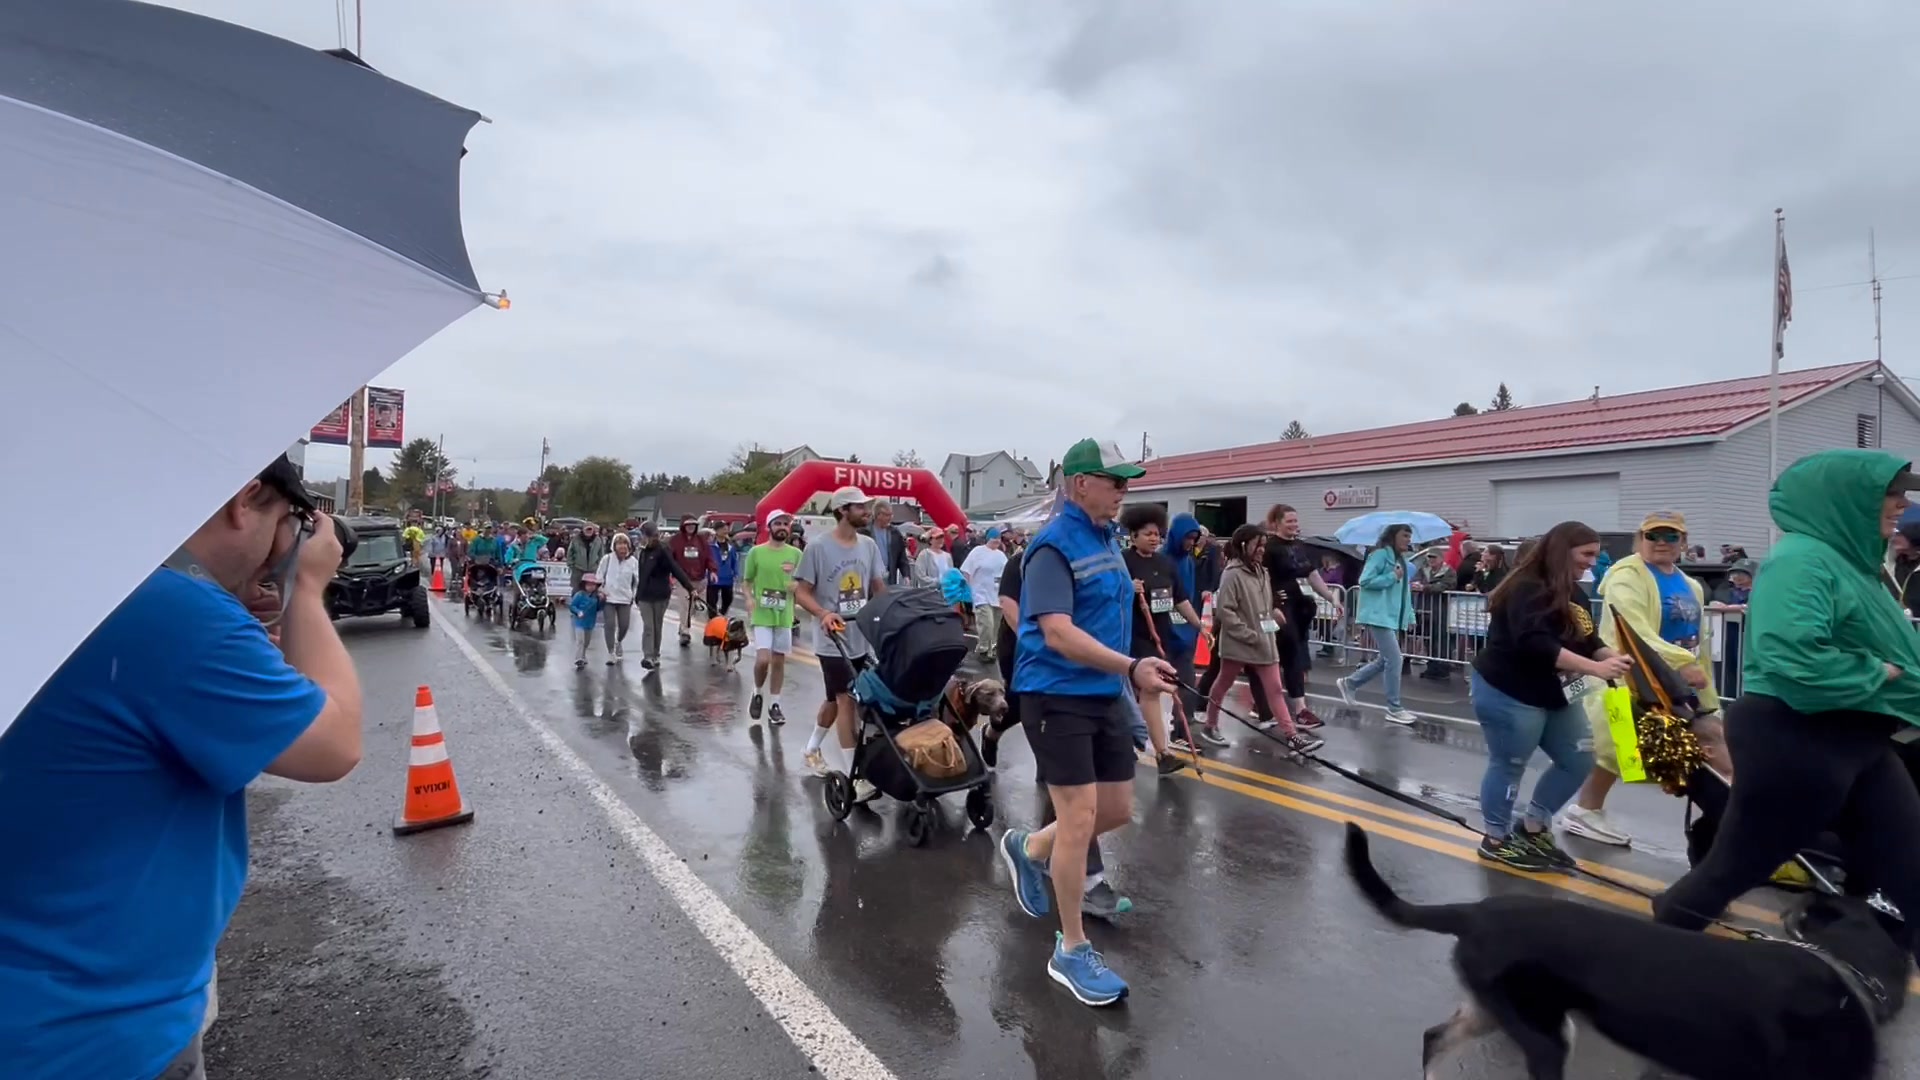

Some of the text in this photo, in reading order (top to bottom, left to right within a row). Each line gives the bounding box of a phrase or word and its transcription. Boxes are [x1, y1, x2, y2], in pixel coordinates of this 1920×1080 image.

[834, 466, 912, 491] FINISH
[846, 600, 861, 611] 853
[1569, 679, 1585, 696] 989
